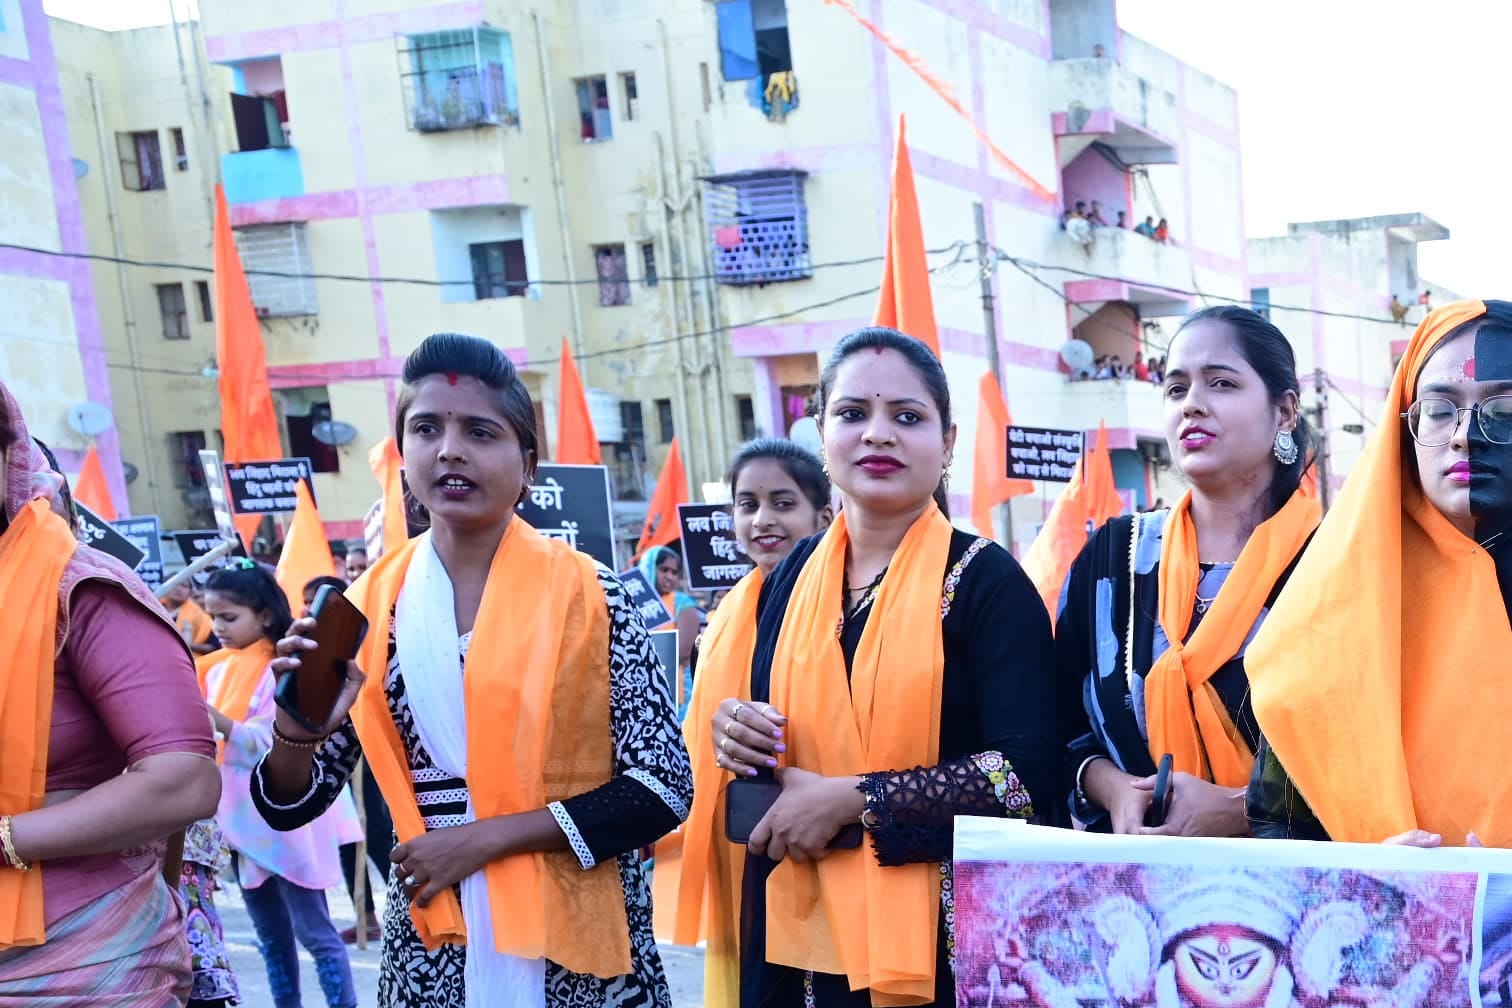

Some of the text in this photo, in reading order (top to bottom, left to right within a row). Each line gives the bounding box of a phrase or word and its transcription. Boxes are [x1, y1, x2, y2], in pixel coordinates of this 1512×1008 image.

[1012, 460, 1025, 475] को
[528, 477, 564, 511] को
[686, 517, 710, 533] लव
[709, 535, 738, 562] हिंदू
